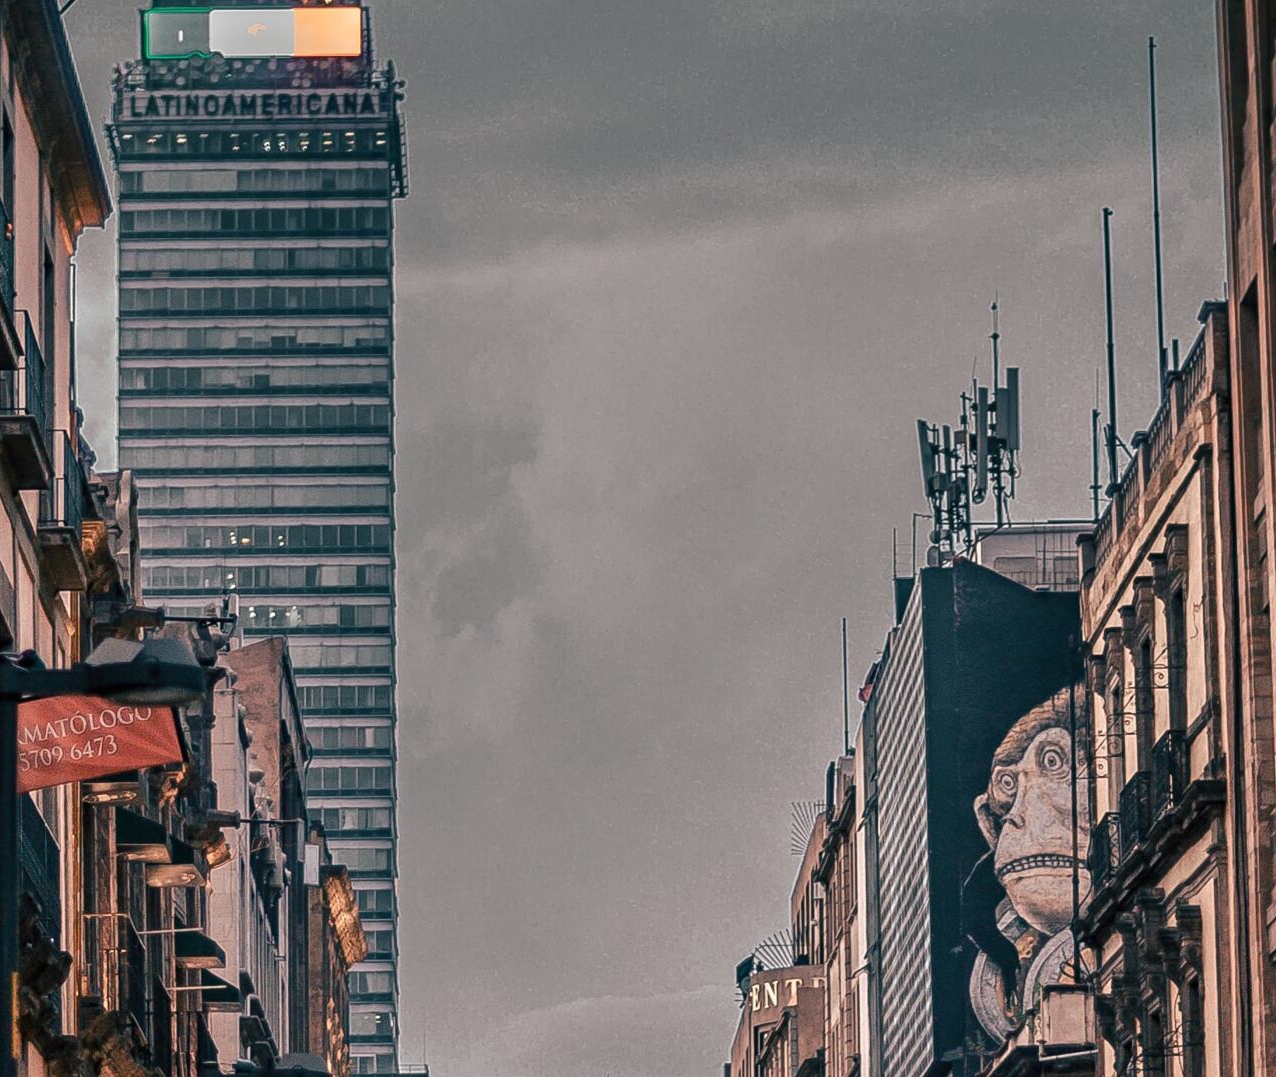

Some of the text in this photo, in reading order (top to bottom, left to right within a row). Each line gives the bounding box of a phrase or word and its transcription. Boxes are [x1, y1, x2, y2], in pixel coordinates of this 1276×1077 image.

[129, 92, 377, 118] LATINOAMERICANA
[19, 734, 118, 772] 5709 6473
